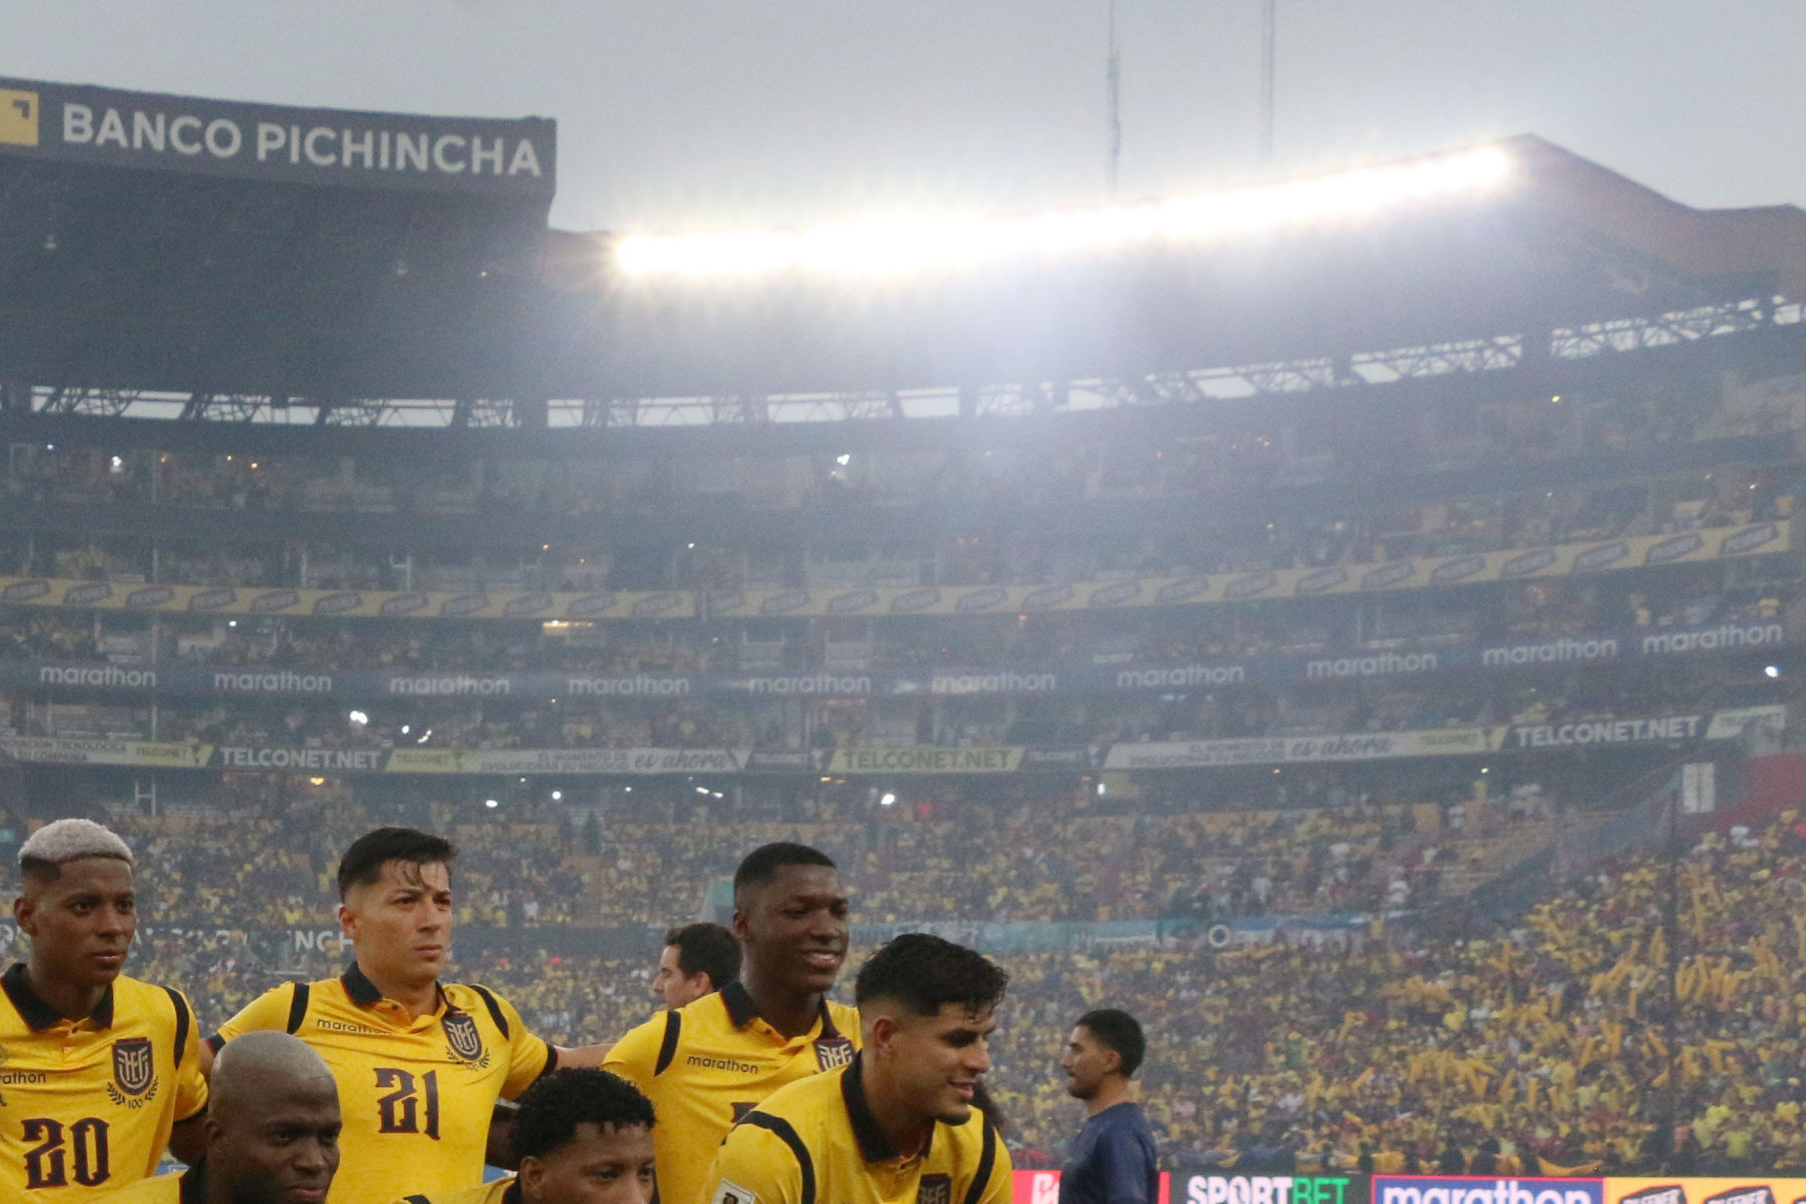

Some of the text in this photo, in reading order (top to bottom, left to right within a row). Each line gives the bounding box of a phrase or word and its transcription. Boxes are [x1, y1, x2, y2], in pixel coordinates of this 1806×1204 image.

[63, 104, 242, 160] BANCO
[257, 123, 542, 177] PICHINCHA
[1643, 623, 1783, 654] marathon
[1483, 637, 1618, 665] marathon
[1117, 663, 1244, 687] marathon
[1306, 650, 1437, 678] marathon
[40, 665, 156, 687] marathon
[214, 672, 332, 693] marathon
[389, 675, 510, 695] marathon
[568, 674, 690, 696] marathon
[750, 674, 871, 694] marathon
[1516, 716, 1701, 748] TELCONET.NET
[220, 747, 381, 769] TELCONET.NET
[844, 750, 1010, 769] TELCONET.NET
[687, 1055, 759, 1075] marathon
[128, 1096, 144, 1109] 100
[373, 1067, 441, 1142] 21
[22, 1117, 111, 1190] 20
